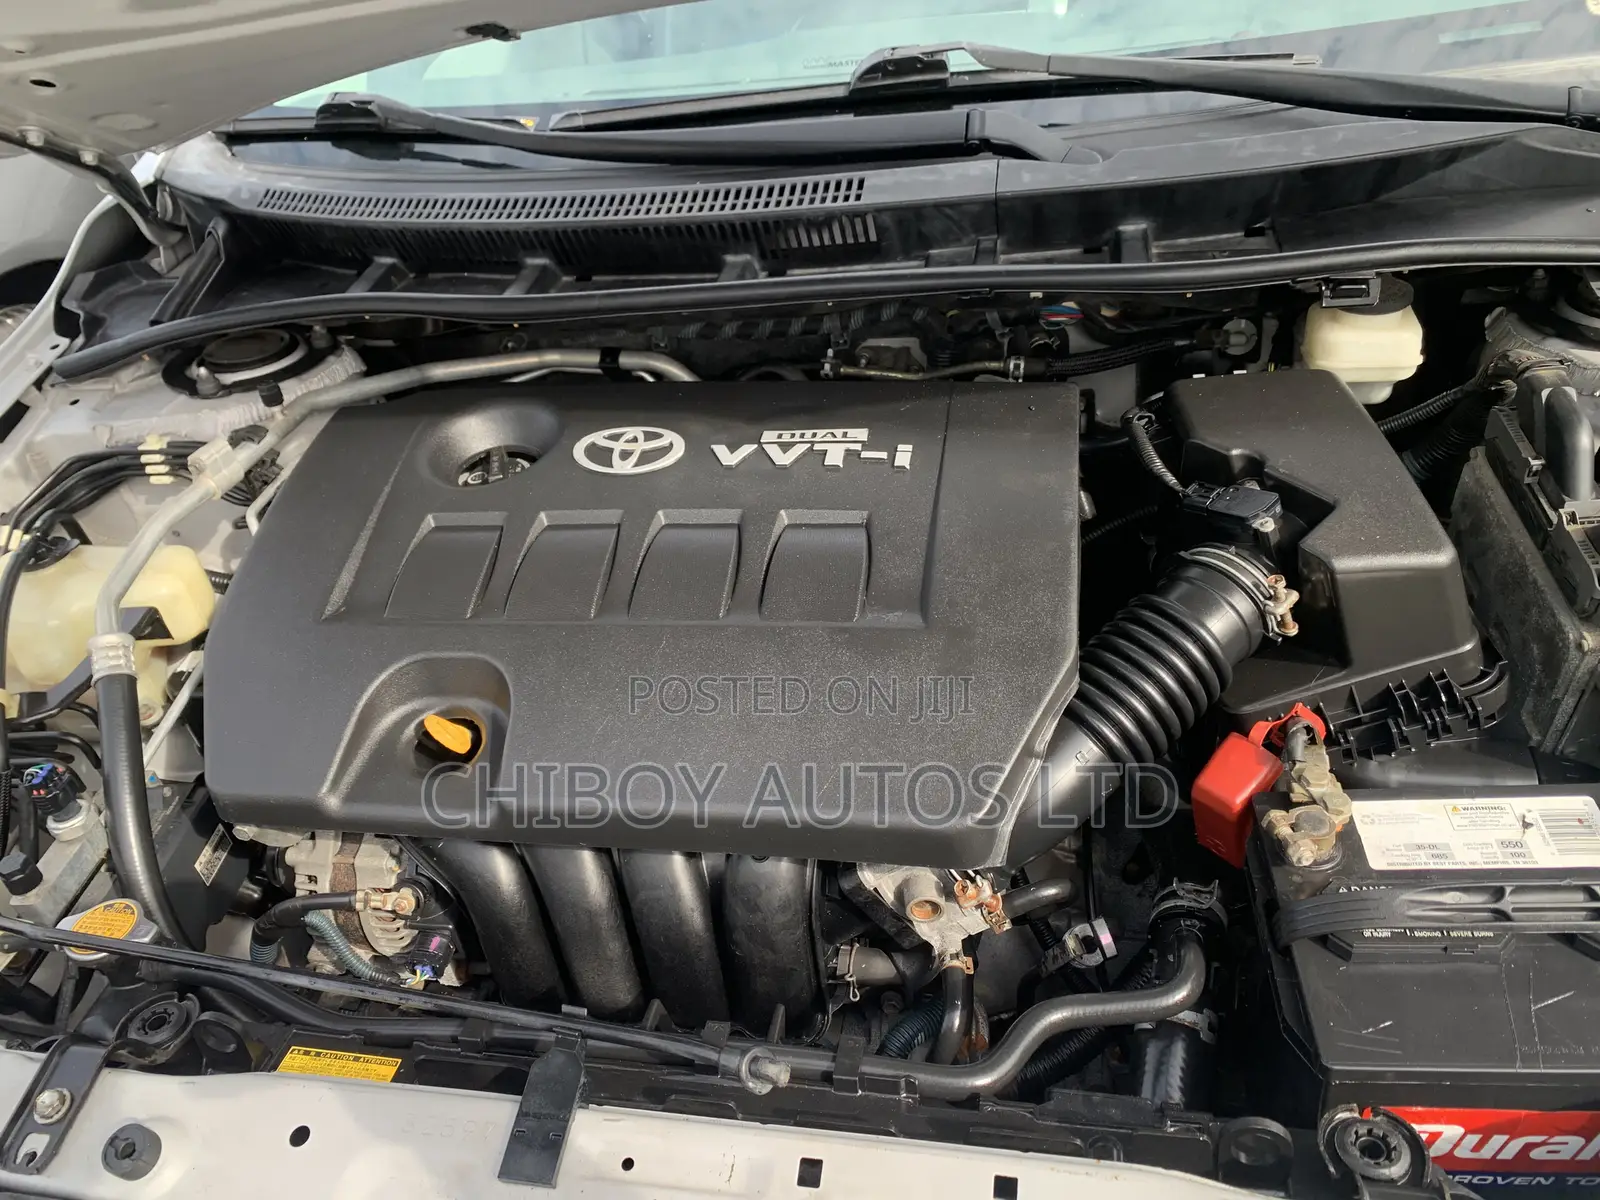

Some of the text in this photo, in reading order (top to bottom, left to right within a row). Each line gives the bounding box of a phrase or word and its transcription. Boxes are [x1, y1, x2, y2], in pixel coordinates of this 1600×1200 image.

[776, 430, 859, 441] DUAL
[711, 443, 913, 468] VVT-i
[1500, 840, 1524, 849] 550
[320, 1052, 355, 1061] CAUTION
[358, 1056, 397, 1066] ATTENTION
[1448, 1174, 1600, 1186] ROVEN TO
